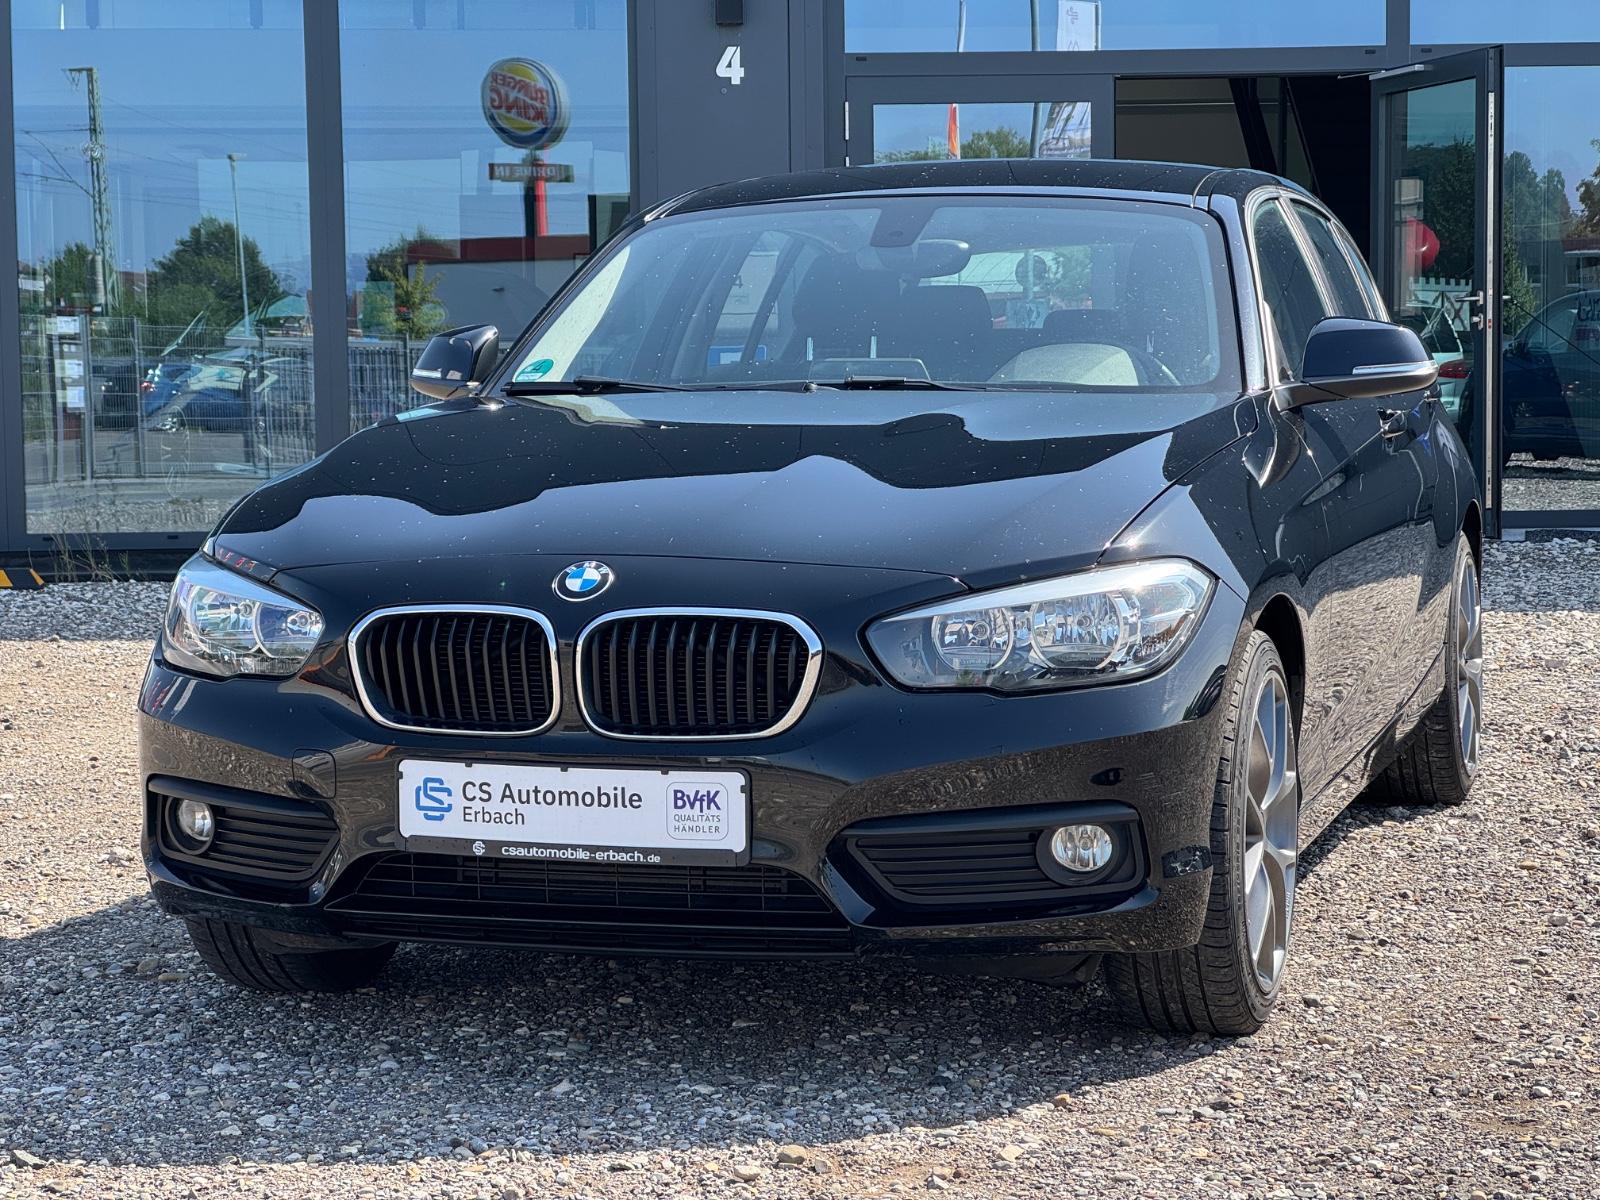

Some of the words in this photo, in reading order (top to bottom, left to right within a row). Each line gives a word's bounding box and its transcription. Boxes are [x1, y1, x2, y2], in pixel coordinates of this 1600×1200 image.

[716, 46, 744, 84] 4
[462, 780, 493, 803] CS
[499, 783, 643, 809] Automobile
[463, 806, 525, 825] Erbach
[674, 813, 721, 823] QUALITÄTS
[674, 824, 720, 833] HÄNDLER
[502, 846, 661, 863] csautomobile-erbach.de
